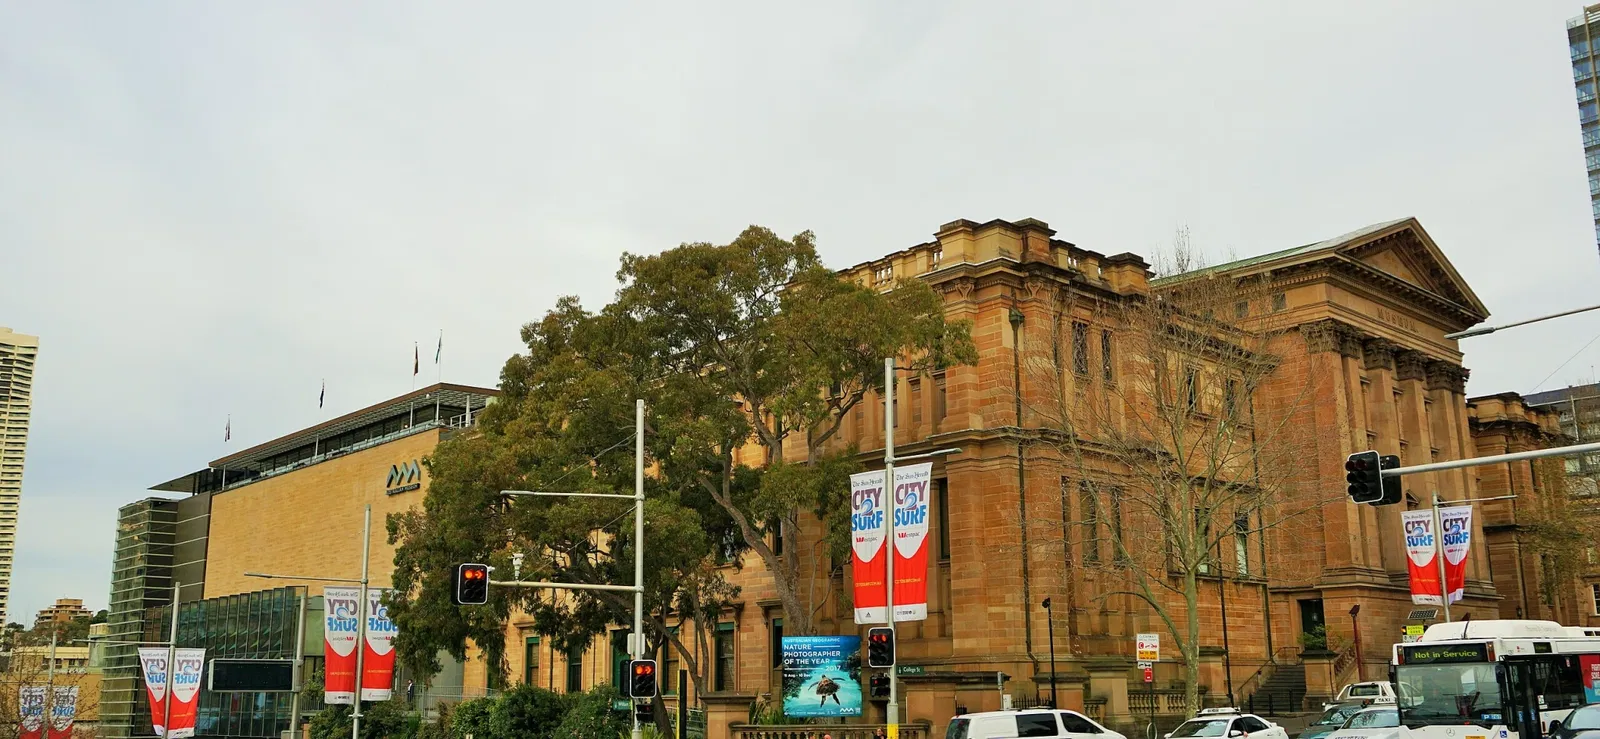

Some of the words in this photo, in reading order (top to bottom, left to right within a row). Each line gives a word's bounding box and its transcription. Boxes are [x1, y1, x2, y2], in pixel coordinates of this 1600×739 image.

[852, 487, 883, 511] CITY
[895, 480, 928, 505] CITY
[904, 492, 918, 511] 2
[861, 498, 874, 517] 2
[894, 504, 927, 527] SURF
[851, 510, 883, 531] SURF
[1405, 520, 1431, 534] CITY
[1442, 517, 1469, 532] CITY
[1407, 534, 1434, 547] SURF
[1443, 531, 1469, 546] SURF
[1443, 650, 1478, 658] Service
